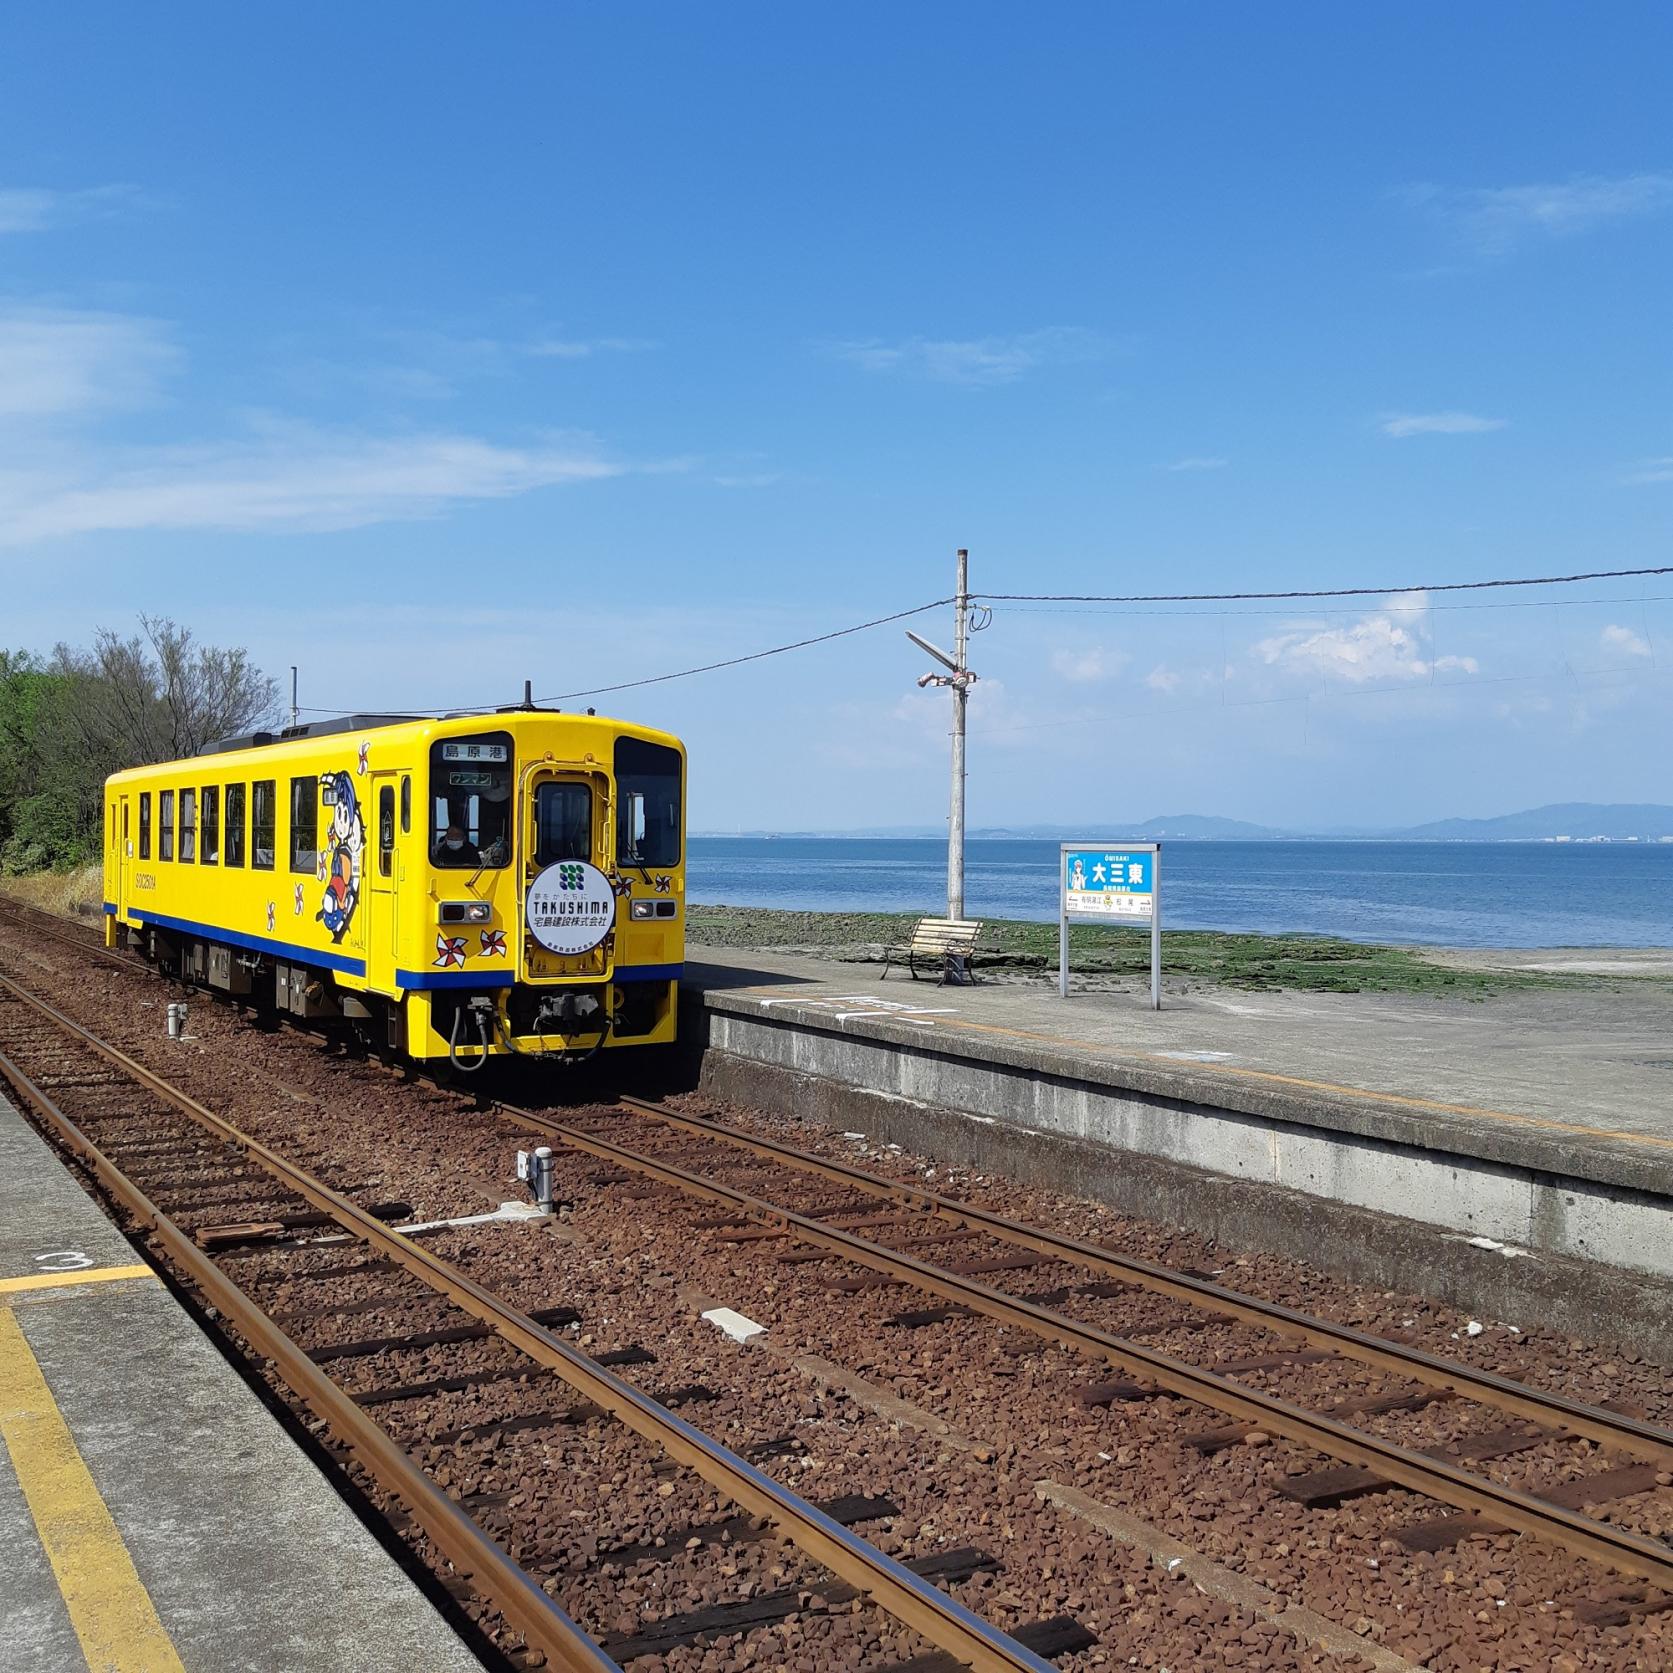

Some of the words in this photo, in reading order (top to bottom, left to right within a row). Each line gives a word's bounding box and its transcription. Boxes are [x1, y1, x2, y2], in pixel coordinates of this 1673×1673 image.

[445, 745, 503, 759] 島原港
[451, 773, 490, 783] ワンマン
[1092, 862, 1144, 884] 大三東
[534, 893, 588, 901] 夢をかたちに
[533, 901, 608, 915] TAKUSHIMA
[533, 916, 607, 928] 宅島建設株式会社
[34, 1251, 95, 1270] 3
